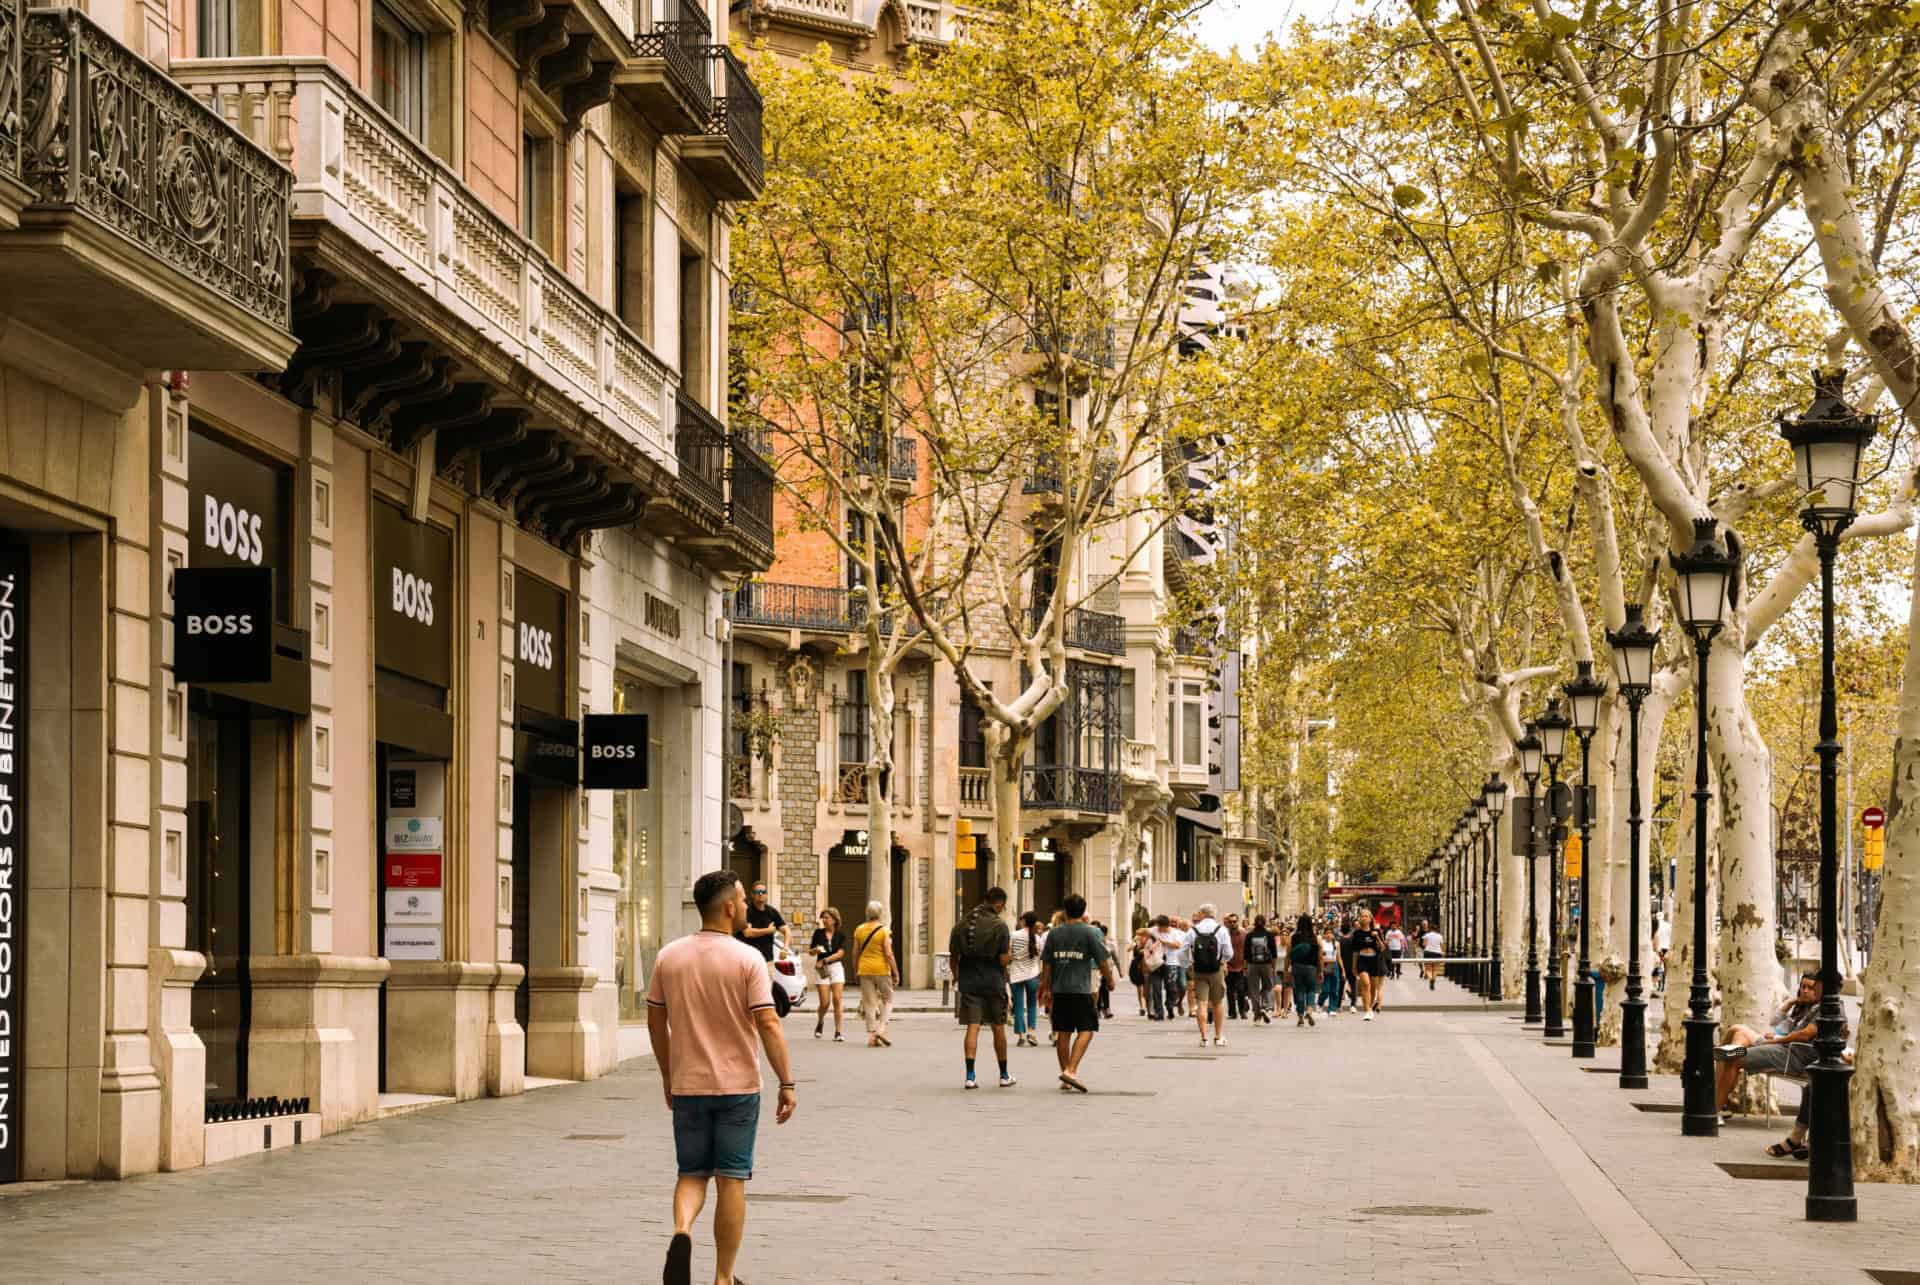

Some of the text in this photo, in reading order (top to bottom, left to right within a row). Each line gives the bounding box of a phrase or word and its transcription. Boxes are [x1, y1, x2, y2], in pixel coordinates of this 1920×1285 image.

[205, 494, 263, 567] BOSS
[393, 567, 434, 627] BOSS
[187, 615, 253, 635] BOSS
[520, 622, 552, 671] BOSS
[591, 745, 636, 759] BOSS
[0, 784, 14, 835] OF
[0, 846, 13, 1000] COLORS
